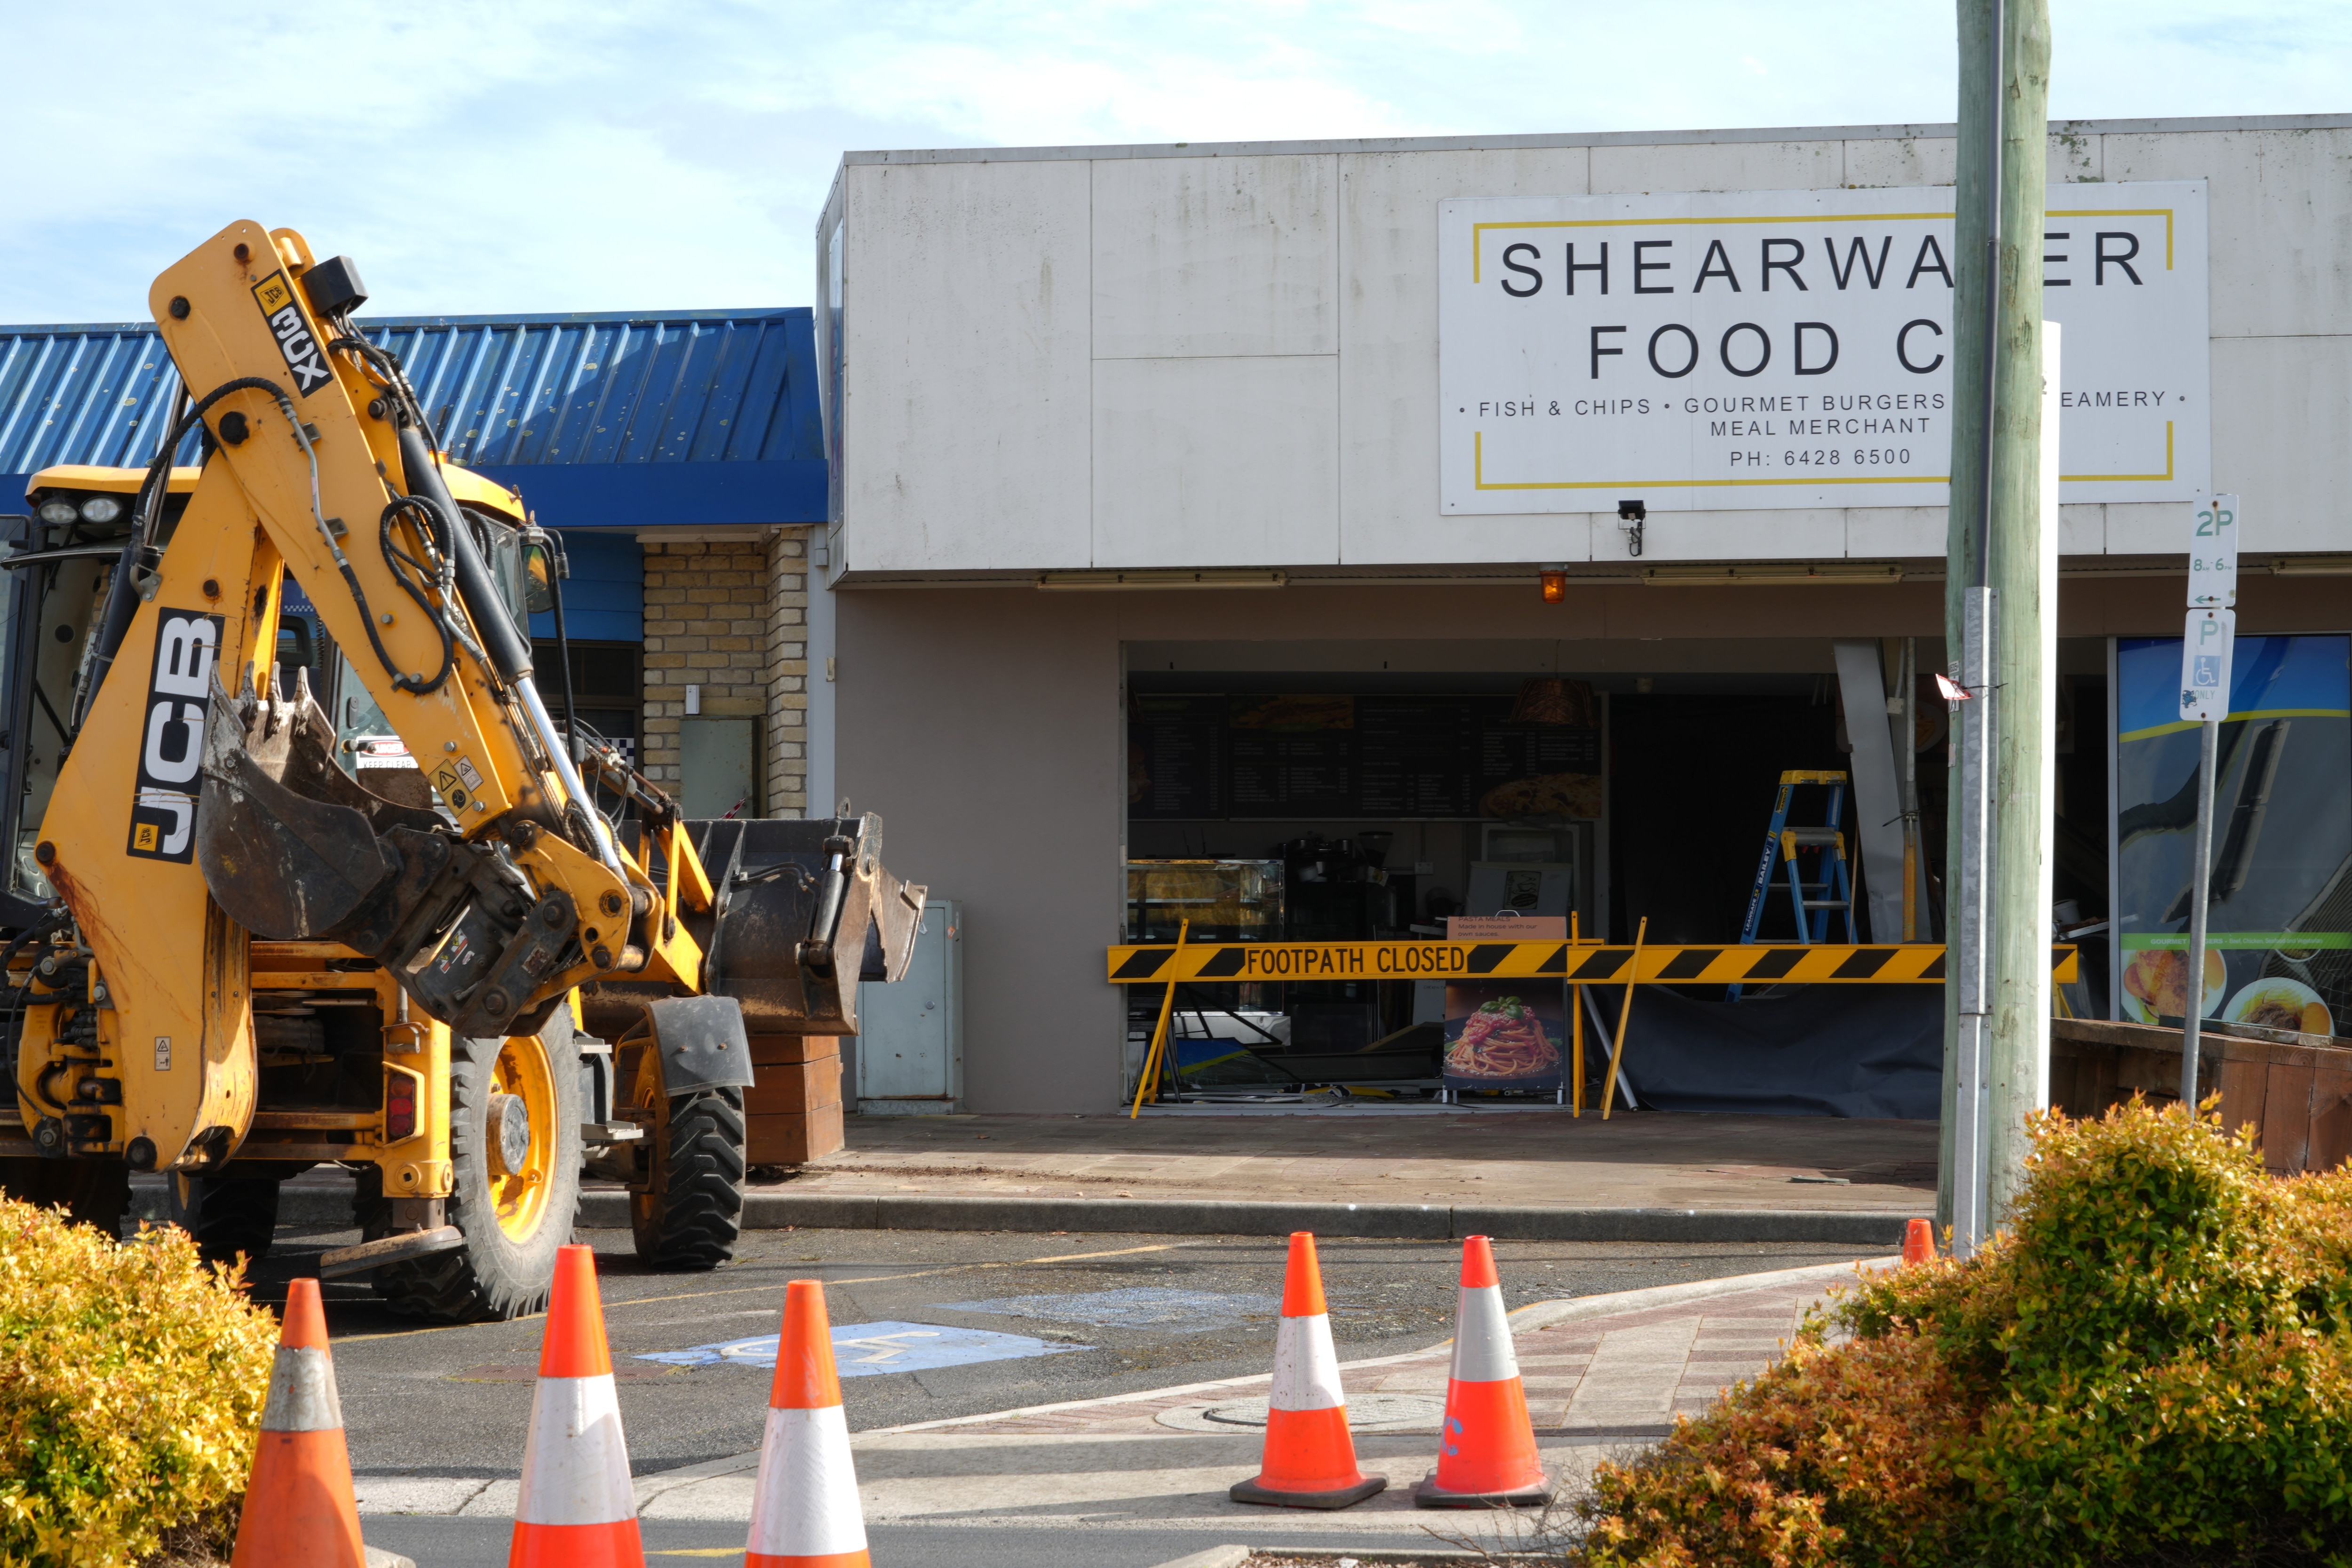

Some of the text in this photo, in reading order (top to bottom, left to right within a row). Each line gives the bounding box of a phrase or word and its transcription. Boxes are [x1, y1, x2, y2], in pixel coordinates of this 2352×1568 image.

[1501, 231, 2143, 296] SHEARWAER
[260, 285, 284, 307] JCB
[1591, 318, 1944, 379] FOOD C
[1480, 391, 2165, 417] FISH & CHIPS GOURMET BURGERS EAMERY
[1712, 418, 1930, 436] MEAL MERCHANT
[1731, 448, 1911, 466] PH: 6428 6500
[2196, 510, 2233, 537] 2P
[2200, 620, 2218, 645] P
[2194, 690, 2215, 700] ONLY
[139, 617, 216, 854] JCB
[373, 743, 404, 754] ANGER
[139, 828, 150, 845] JCB
[1757, 848, 1771, 885] BAILEY
[1745, 898, 1757, 931] LEANSAFE
[1248, 947, 1464, 974] FOOTPATH CLOSED
